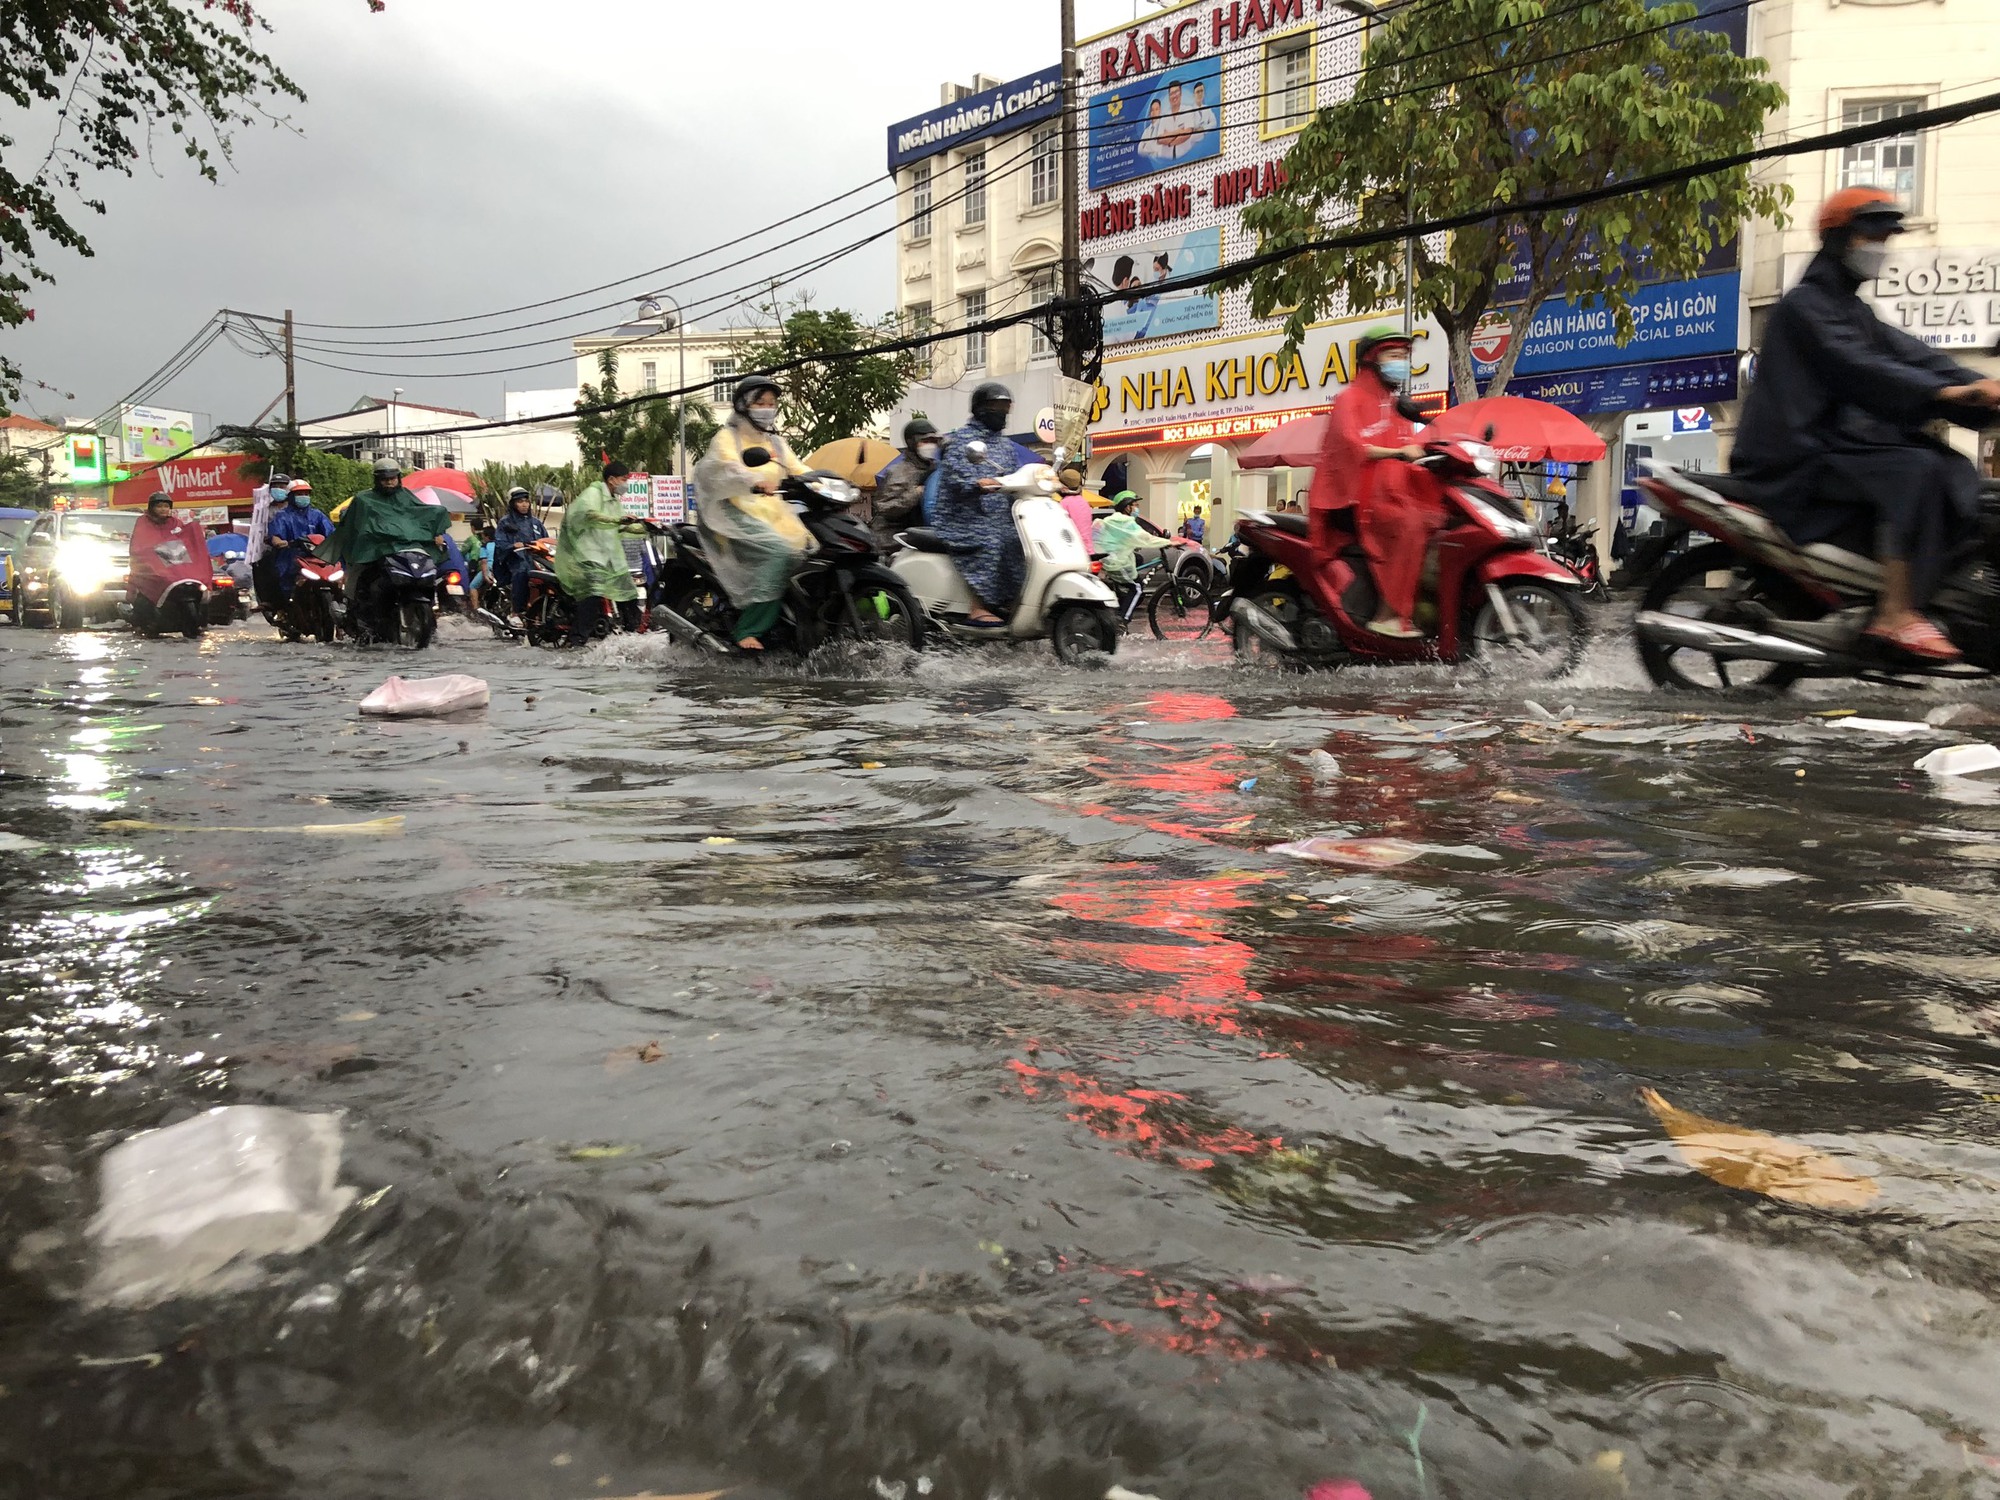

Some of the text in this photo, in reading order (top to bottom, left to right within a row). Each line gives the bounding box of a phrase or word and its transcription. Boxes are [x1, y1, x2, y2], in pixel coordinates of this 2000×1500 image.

[1100, 18, 1199, 85] RĂNG
[898, 79, 1057, 153] NGÂN HÀNG Á CHÂU
[1140, 183, 1192, 227] RĂNG
[1213, 157, 1290, 209] IMPLAN
[1524, 320, 1716, 357] SAIGON COMMRCIAL BANK
[1525, 314, 1563, 340] NGÂN
[1567, 309, 1606, 334] HÀNG
[1653, 296, 1678, 322] SÀI
[1683, 291, 1717, 317] GÒN
[1896, 300, 1975, 327] TEA
[1121, 366, 1196, 413] NHA
[1205, 349, 1310, 402] KHOA
[1540, 381, 1584, 399] beYOU
